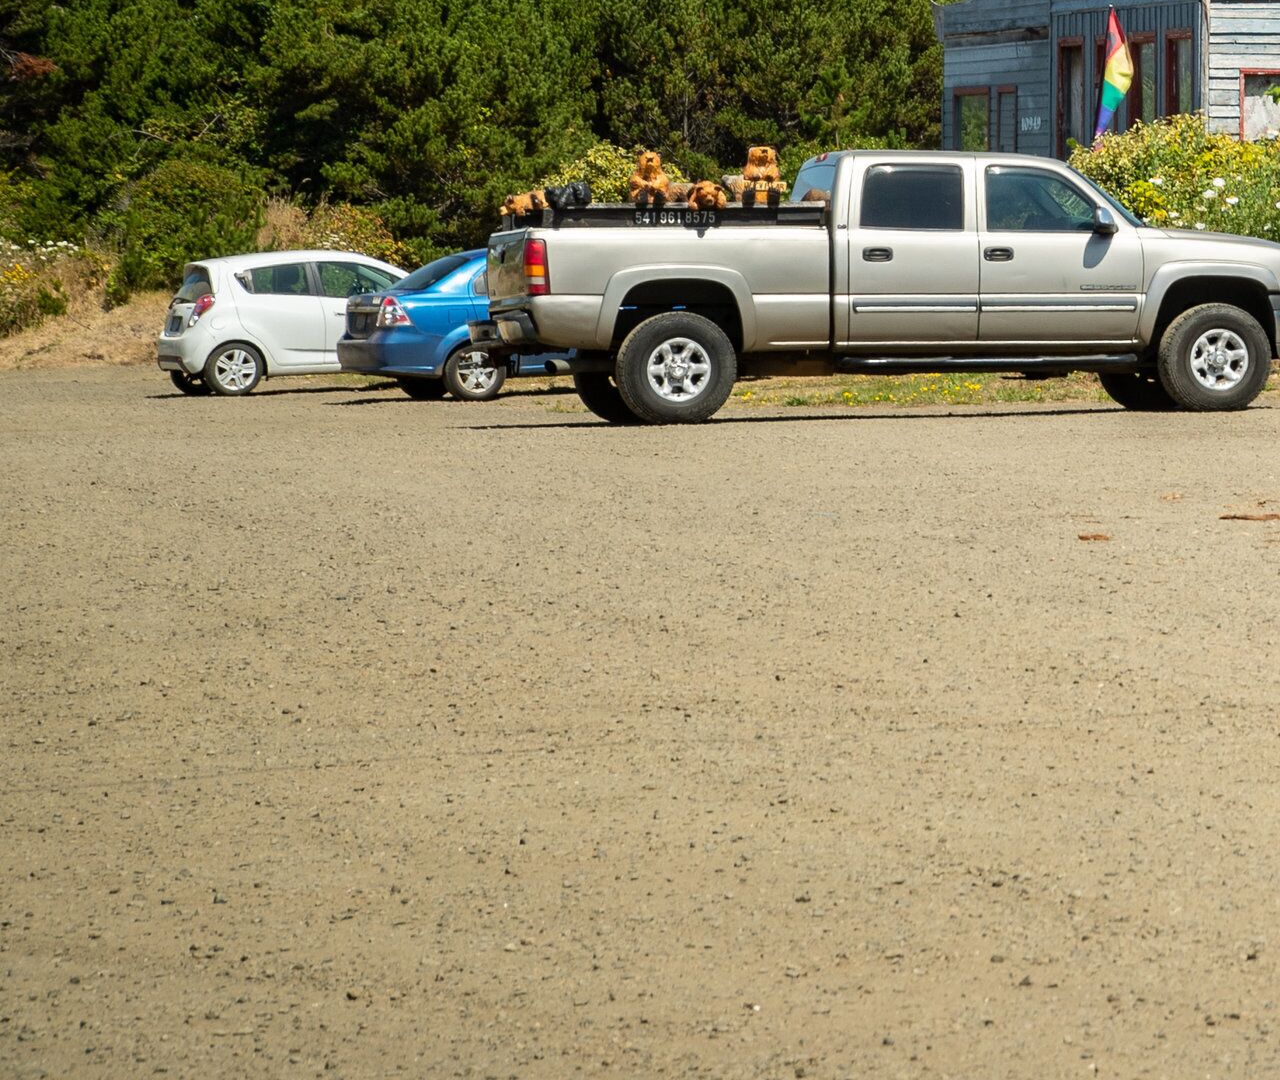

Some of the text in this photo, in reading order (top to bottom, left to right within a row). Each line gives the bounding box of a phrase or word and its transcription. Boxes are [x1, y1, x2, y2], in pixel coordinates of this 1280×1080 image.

[635, 211, 716, 224] 541 961 8575
